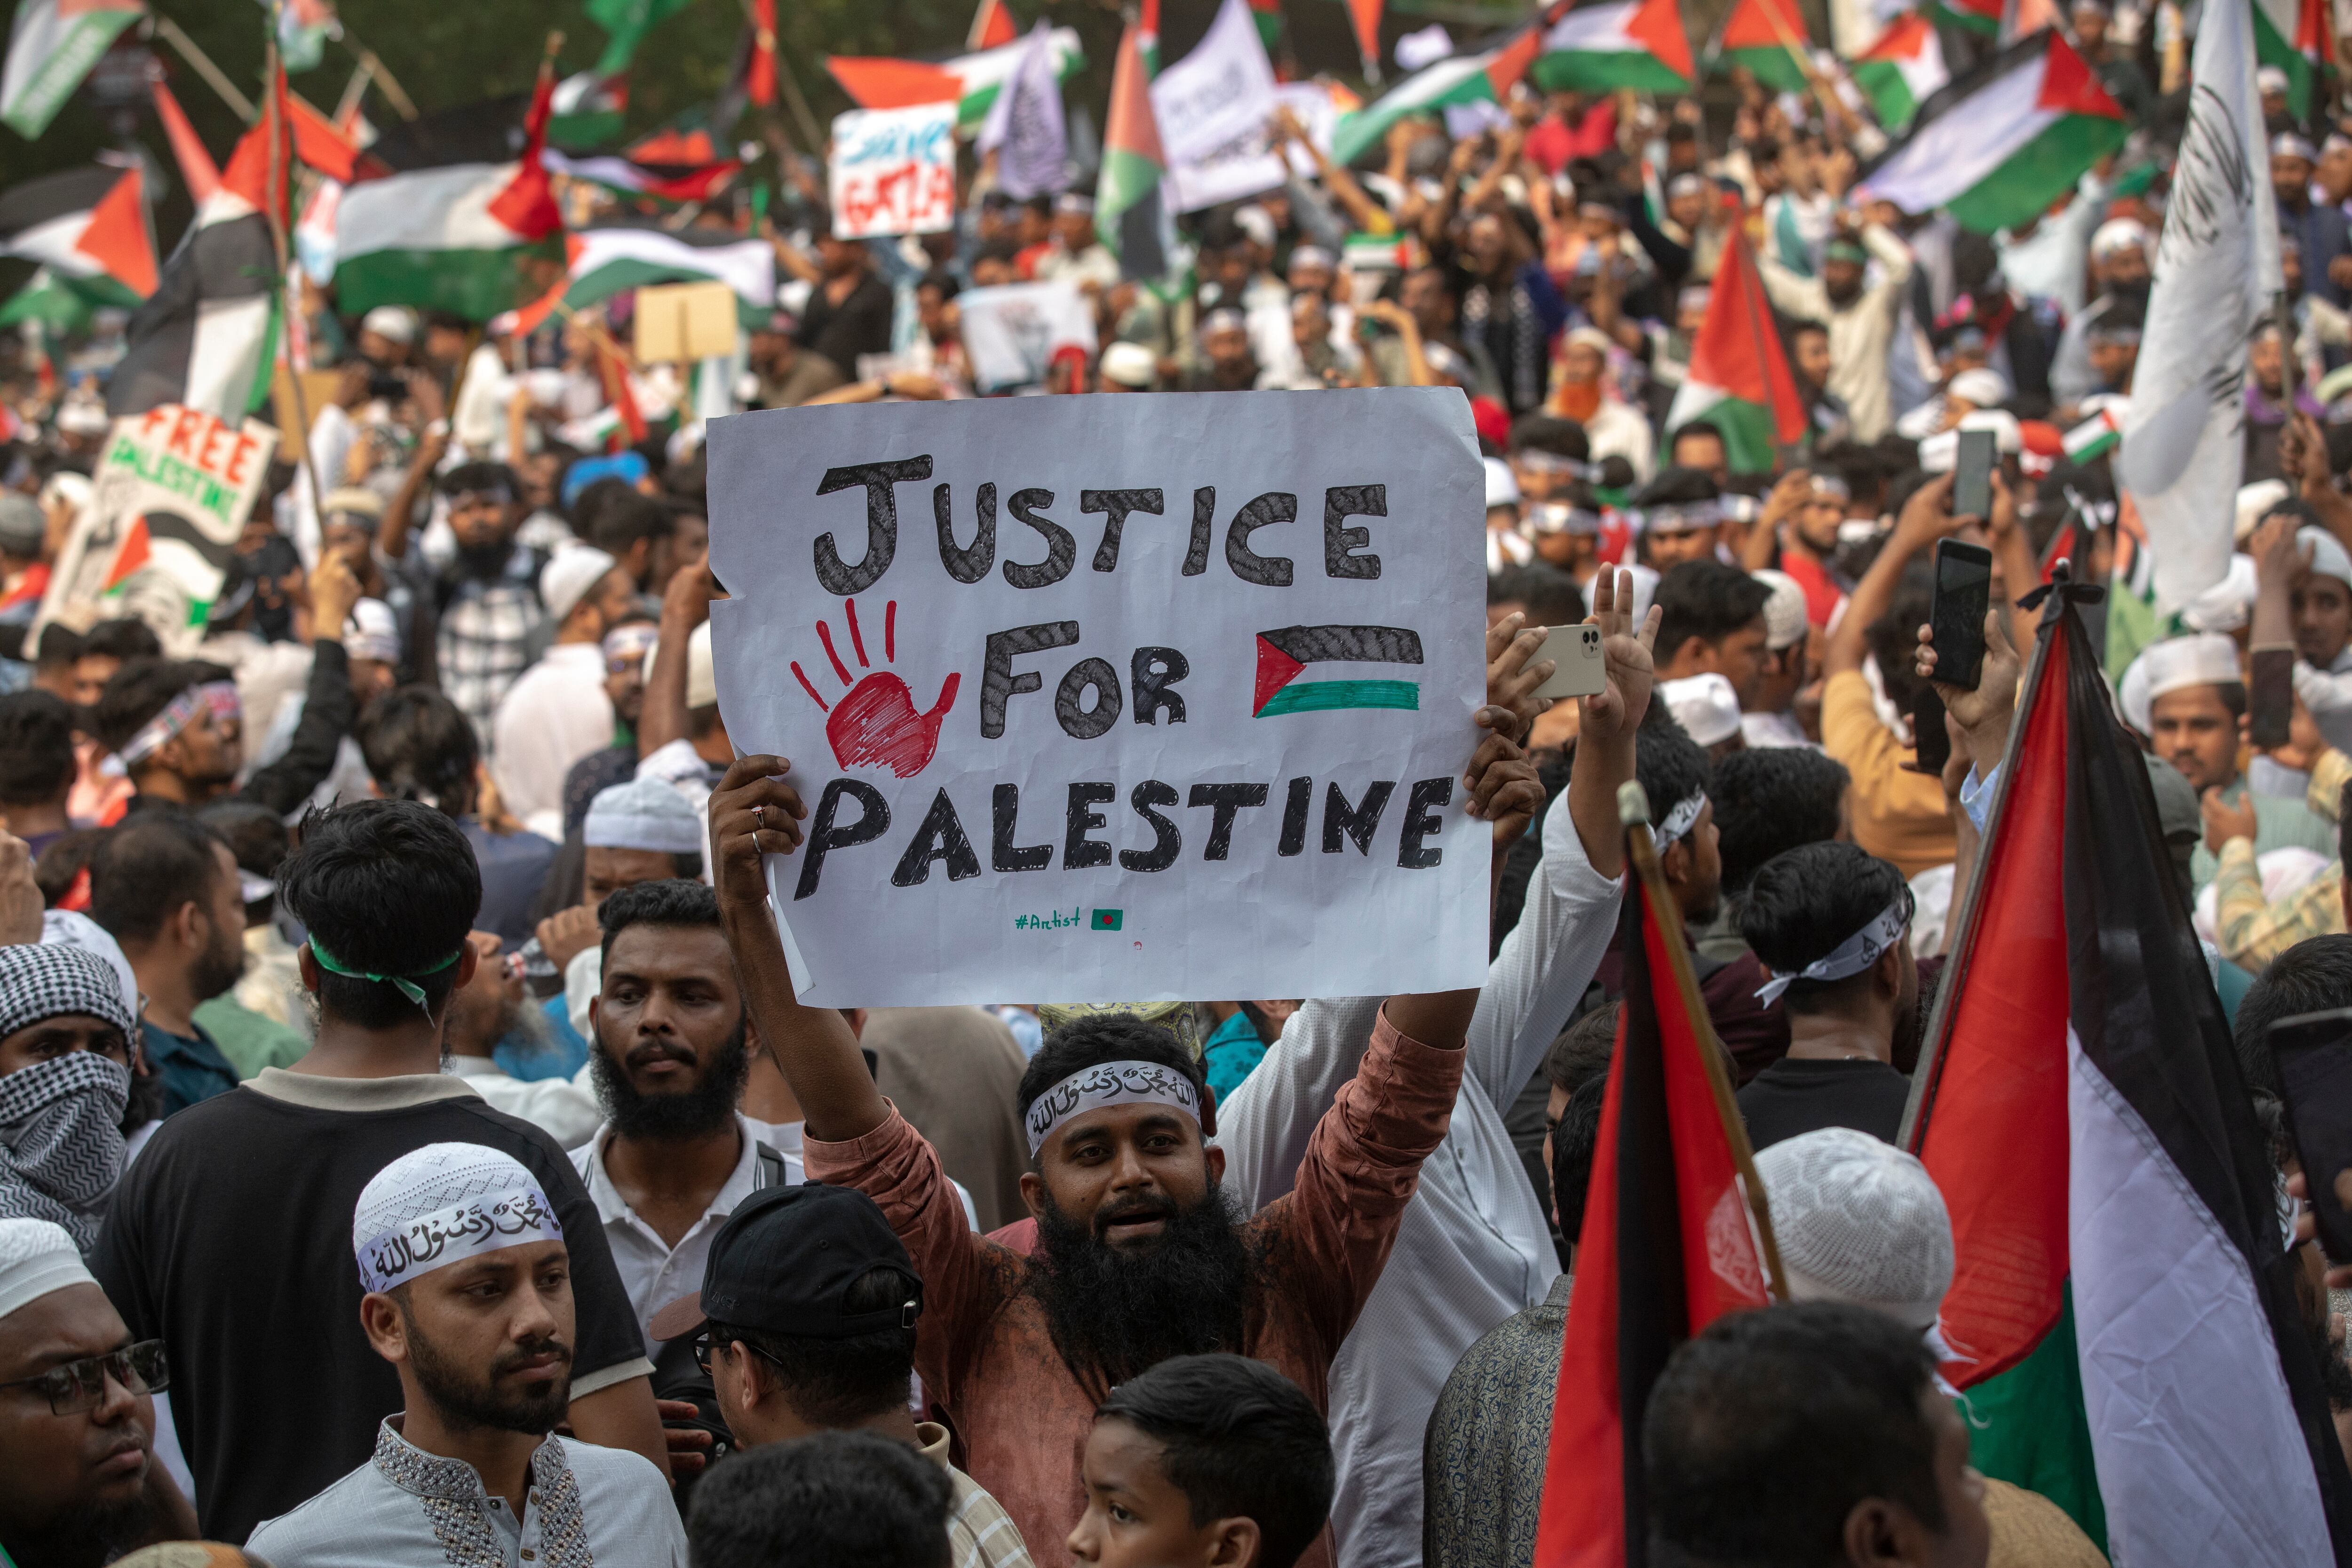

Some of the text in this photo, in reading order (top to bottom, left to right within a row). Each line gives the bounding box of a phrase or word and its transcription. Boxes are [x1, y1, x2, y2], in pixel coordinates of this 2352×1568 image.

[143, 405, 259, 484] FREE
[813, 454, 1388, 596] JUSTICE
[980, 620, 1190, 740] FOR
[794, 775, 1454, 901] PALESTINE
[1015, 906, 1081, 930] #Artist
